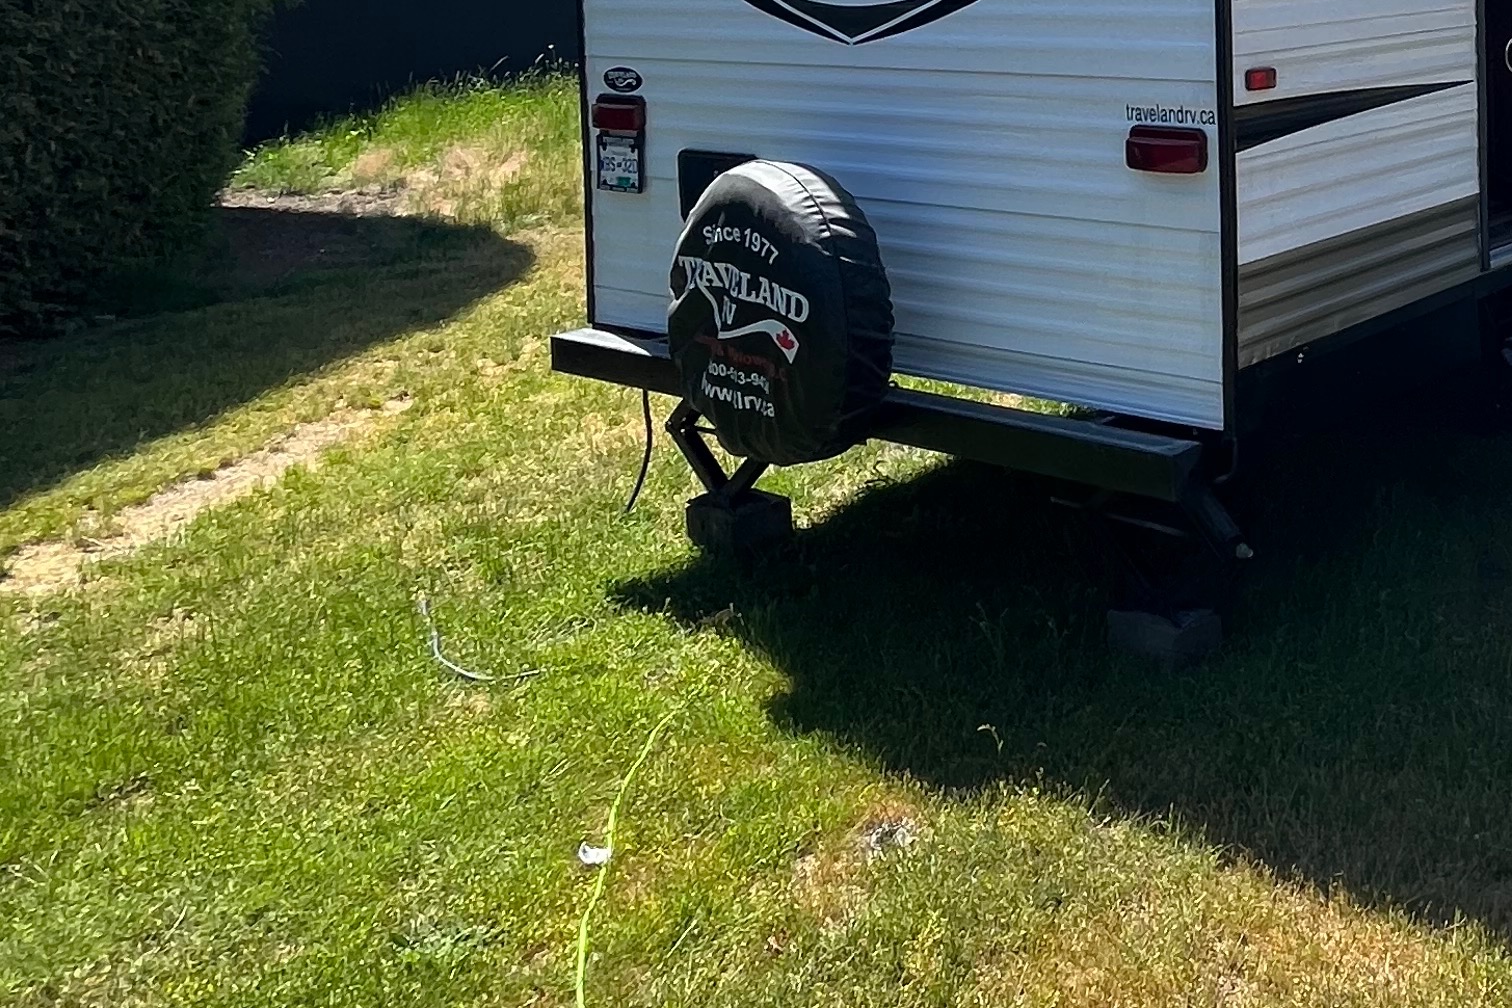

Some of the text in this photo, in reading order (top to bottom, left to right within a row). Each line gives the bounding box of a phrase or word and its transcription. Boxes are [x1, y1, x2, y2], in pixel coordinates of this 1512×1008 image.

[1125, 103, 1217, 126] travelandrv.ca
[702, 224, 779, 265] Since 1977
